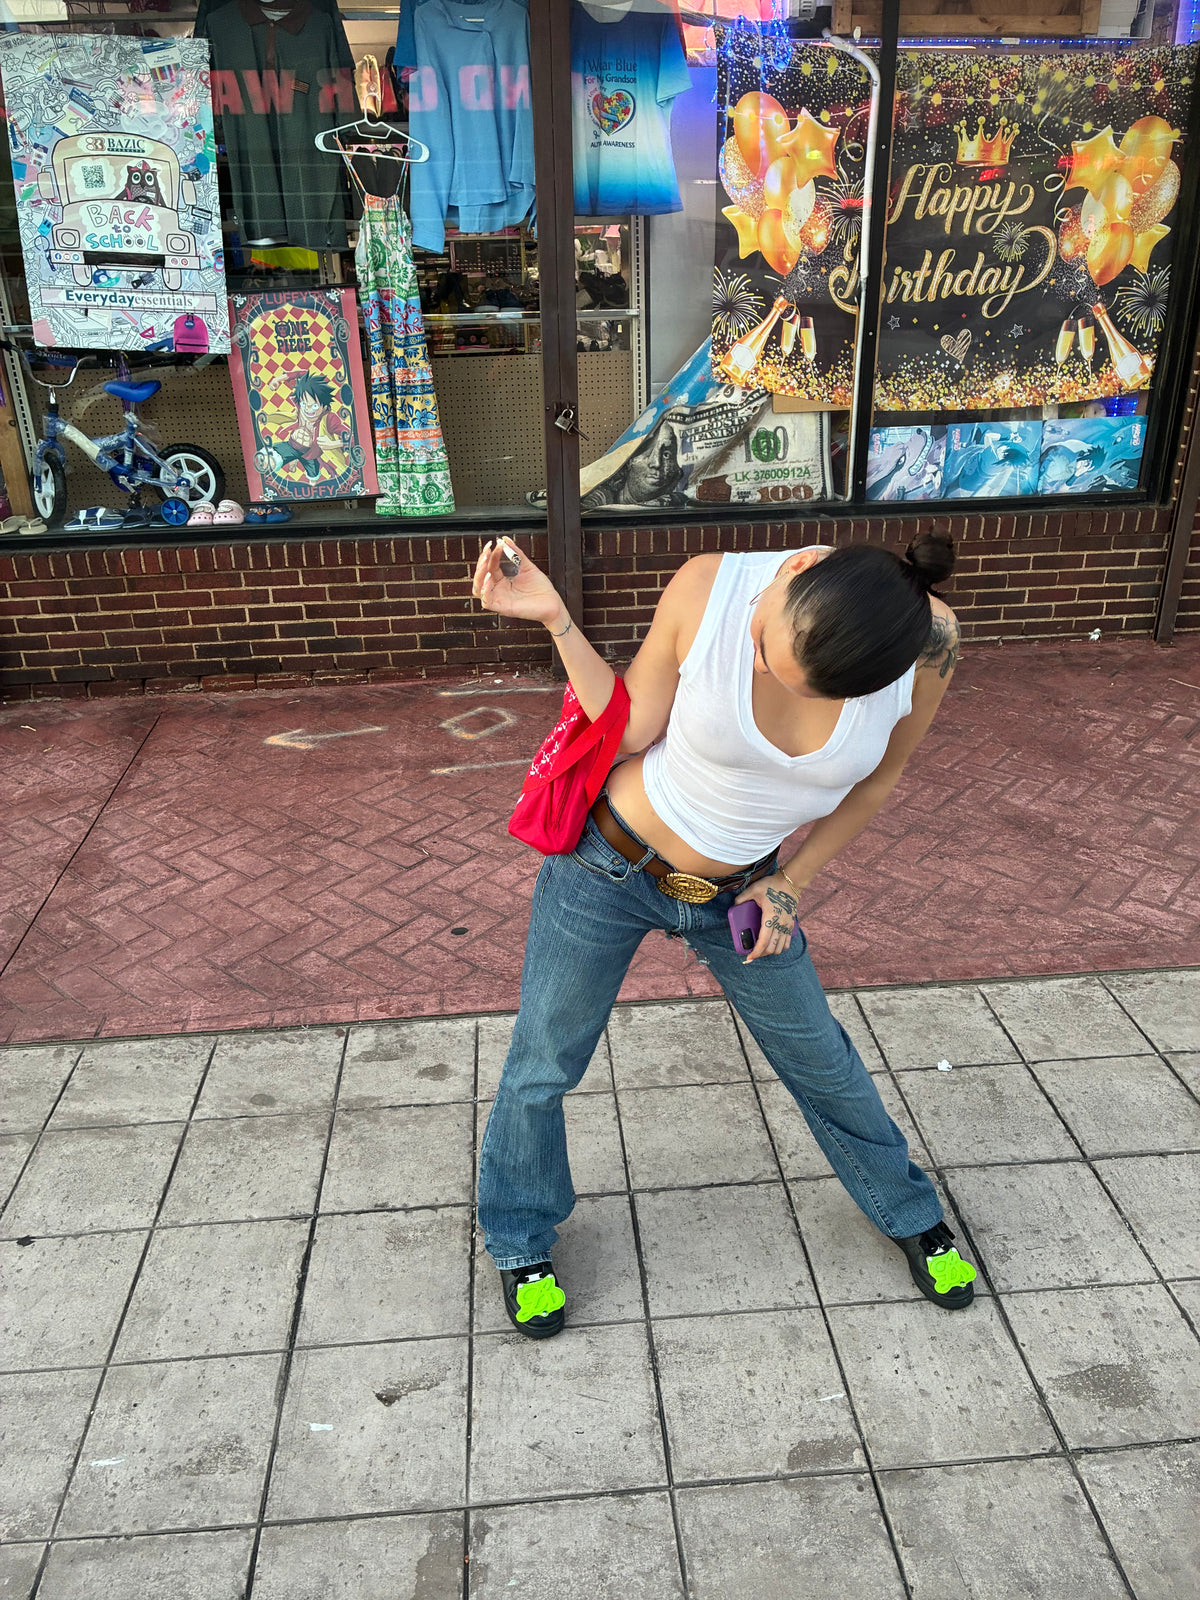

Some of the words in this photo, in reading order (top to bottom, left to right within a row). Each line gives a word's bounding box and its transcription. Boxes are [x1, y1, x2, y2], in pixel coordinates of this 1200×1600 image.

[587, 58, 613, 73] War
[615, 58, 638, 73] Blue
[107, 138, 146, 150] BAZIC
[603, 139, 636, 149] AWARENESS
[887, 162, 1036, 235] Happy
[86, 203, 155, 232] BACK
[111, 224, 132, 234] to
[85, 232, 159, 252] SCHOOL
[265, 290, 308, 305] LUFFY
[272, 319, 310, 339] ONE
[276, 338, 312, 353] PIECE
[735, 472, 750, 482] LK
[294, 485, 335, 498] LUFFY
[757, 485, 814, 502] 100
